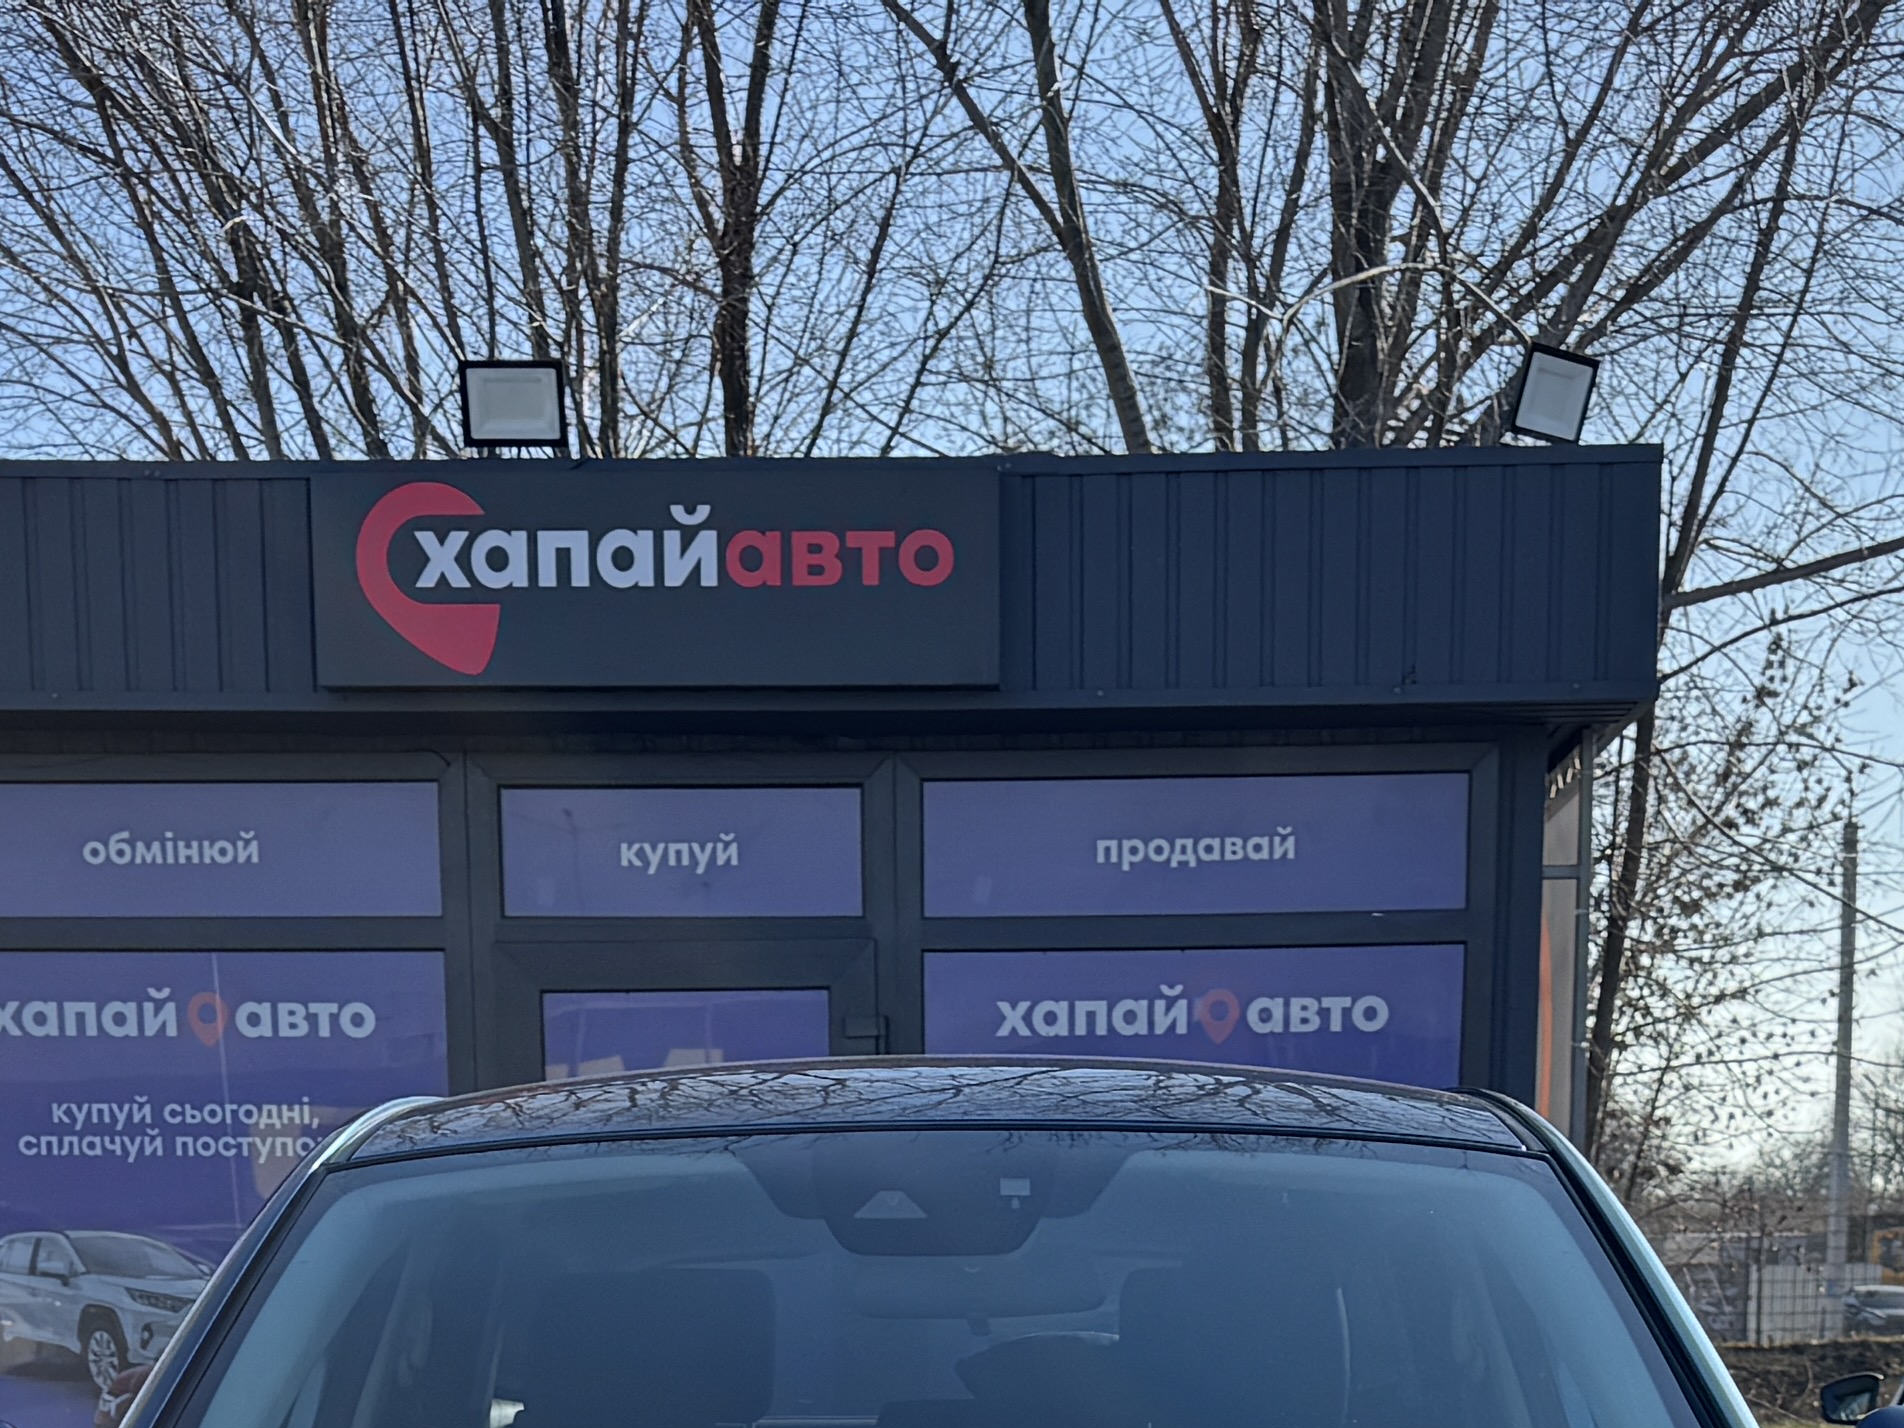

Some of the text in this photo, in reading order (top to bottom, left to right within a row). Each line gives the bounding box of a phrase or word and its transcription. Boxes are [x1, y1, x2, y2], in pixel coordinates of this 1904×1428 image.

[413, 504, 955, 588] хапайавто
[82, 831, 260, 865] обмінюй
[620, 833, 739, 875] купуй
[1096, 826, 1295, 871] продавай
[235, 1001, 376, 1039] авто
[996, 984, 1390, 1038] хапай авто
[51, 1095, 320, 1131] купуй сьогодні,
[18, 1128, 323, 1164] сплачуй поступо
